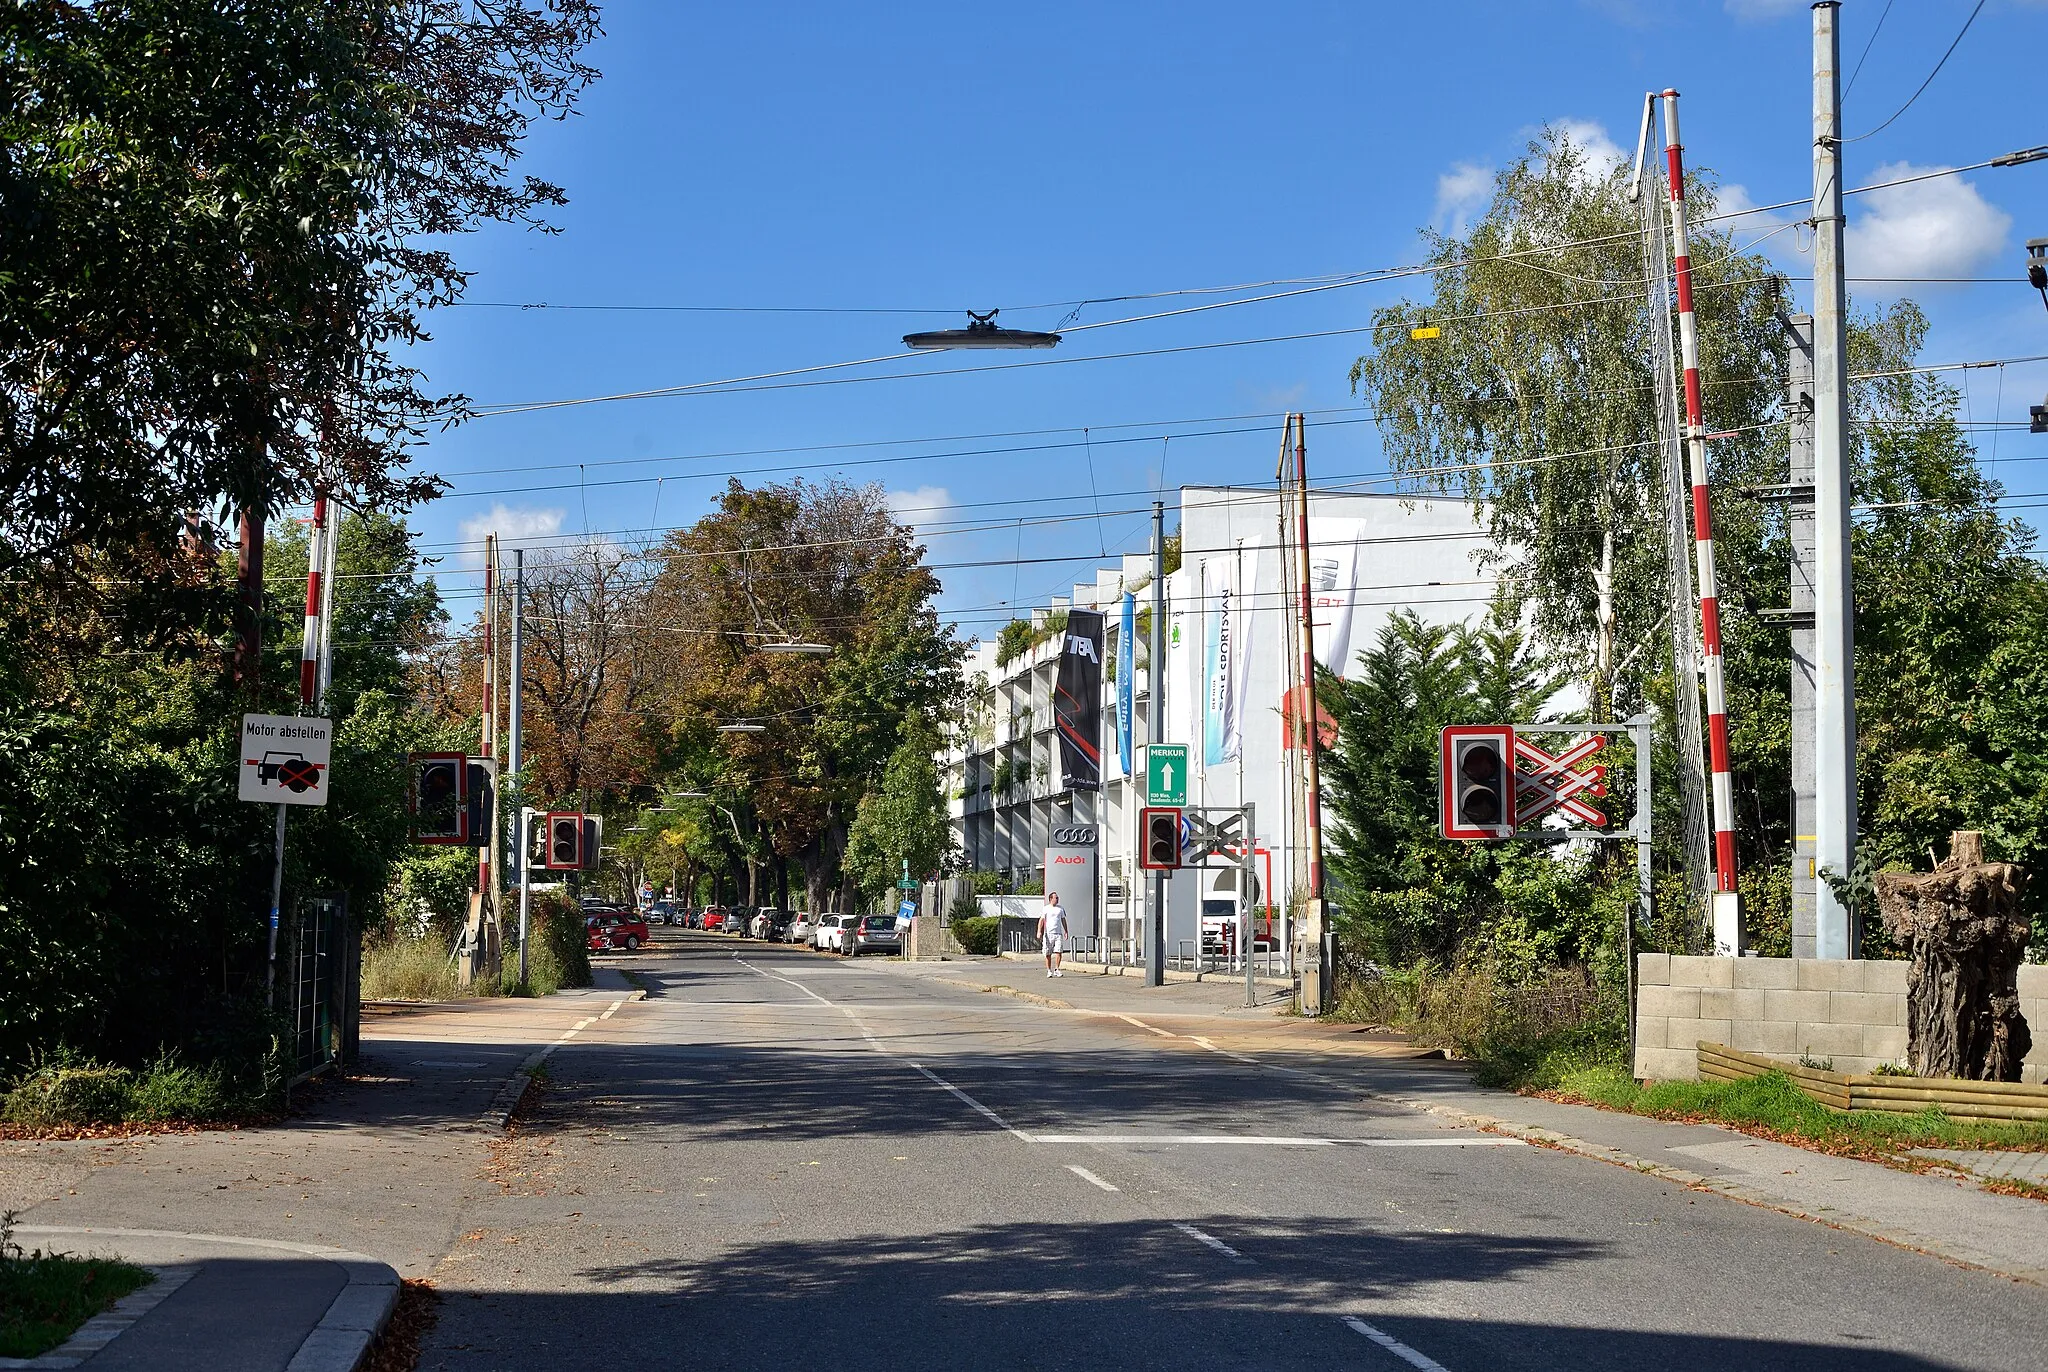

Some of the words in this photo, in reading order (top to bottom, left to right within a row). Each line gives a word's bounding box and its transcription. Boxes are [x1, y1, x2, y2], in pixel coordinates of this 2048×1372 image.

[246, 722, 276, 737] Motor
[279, 724, 326, 740] abstellen
[1054, 855, 1086, 864] Audi
